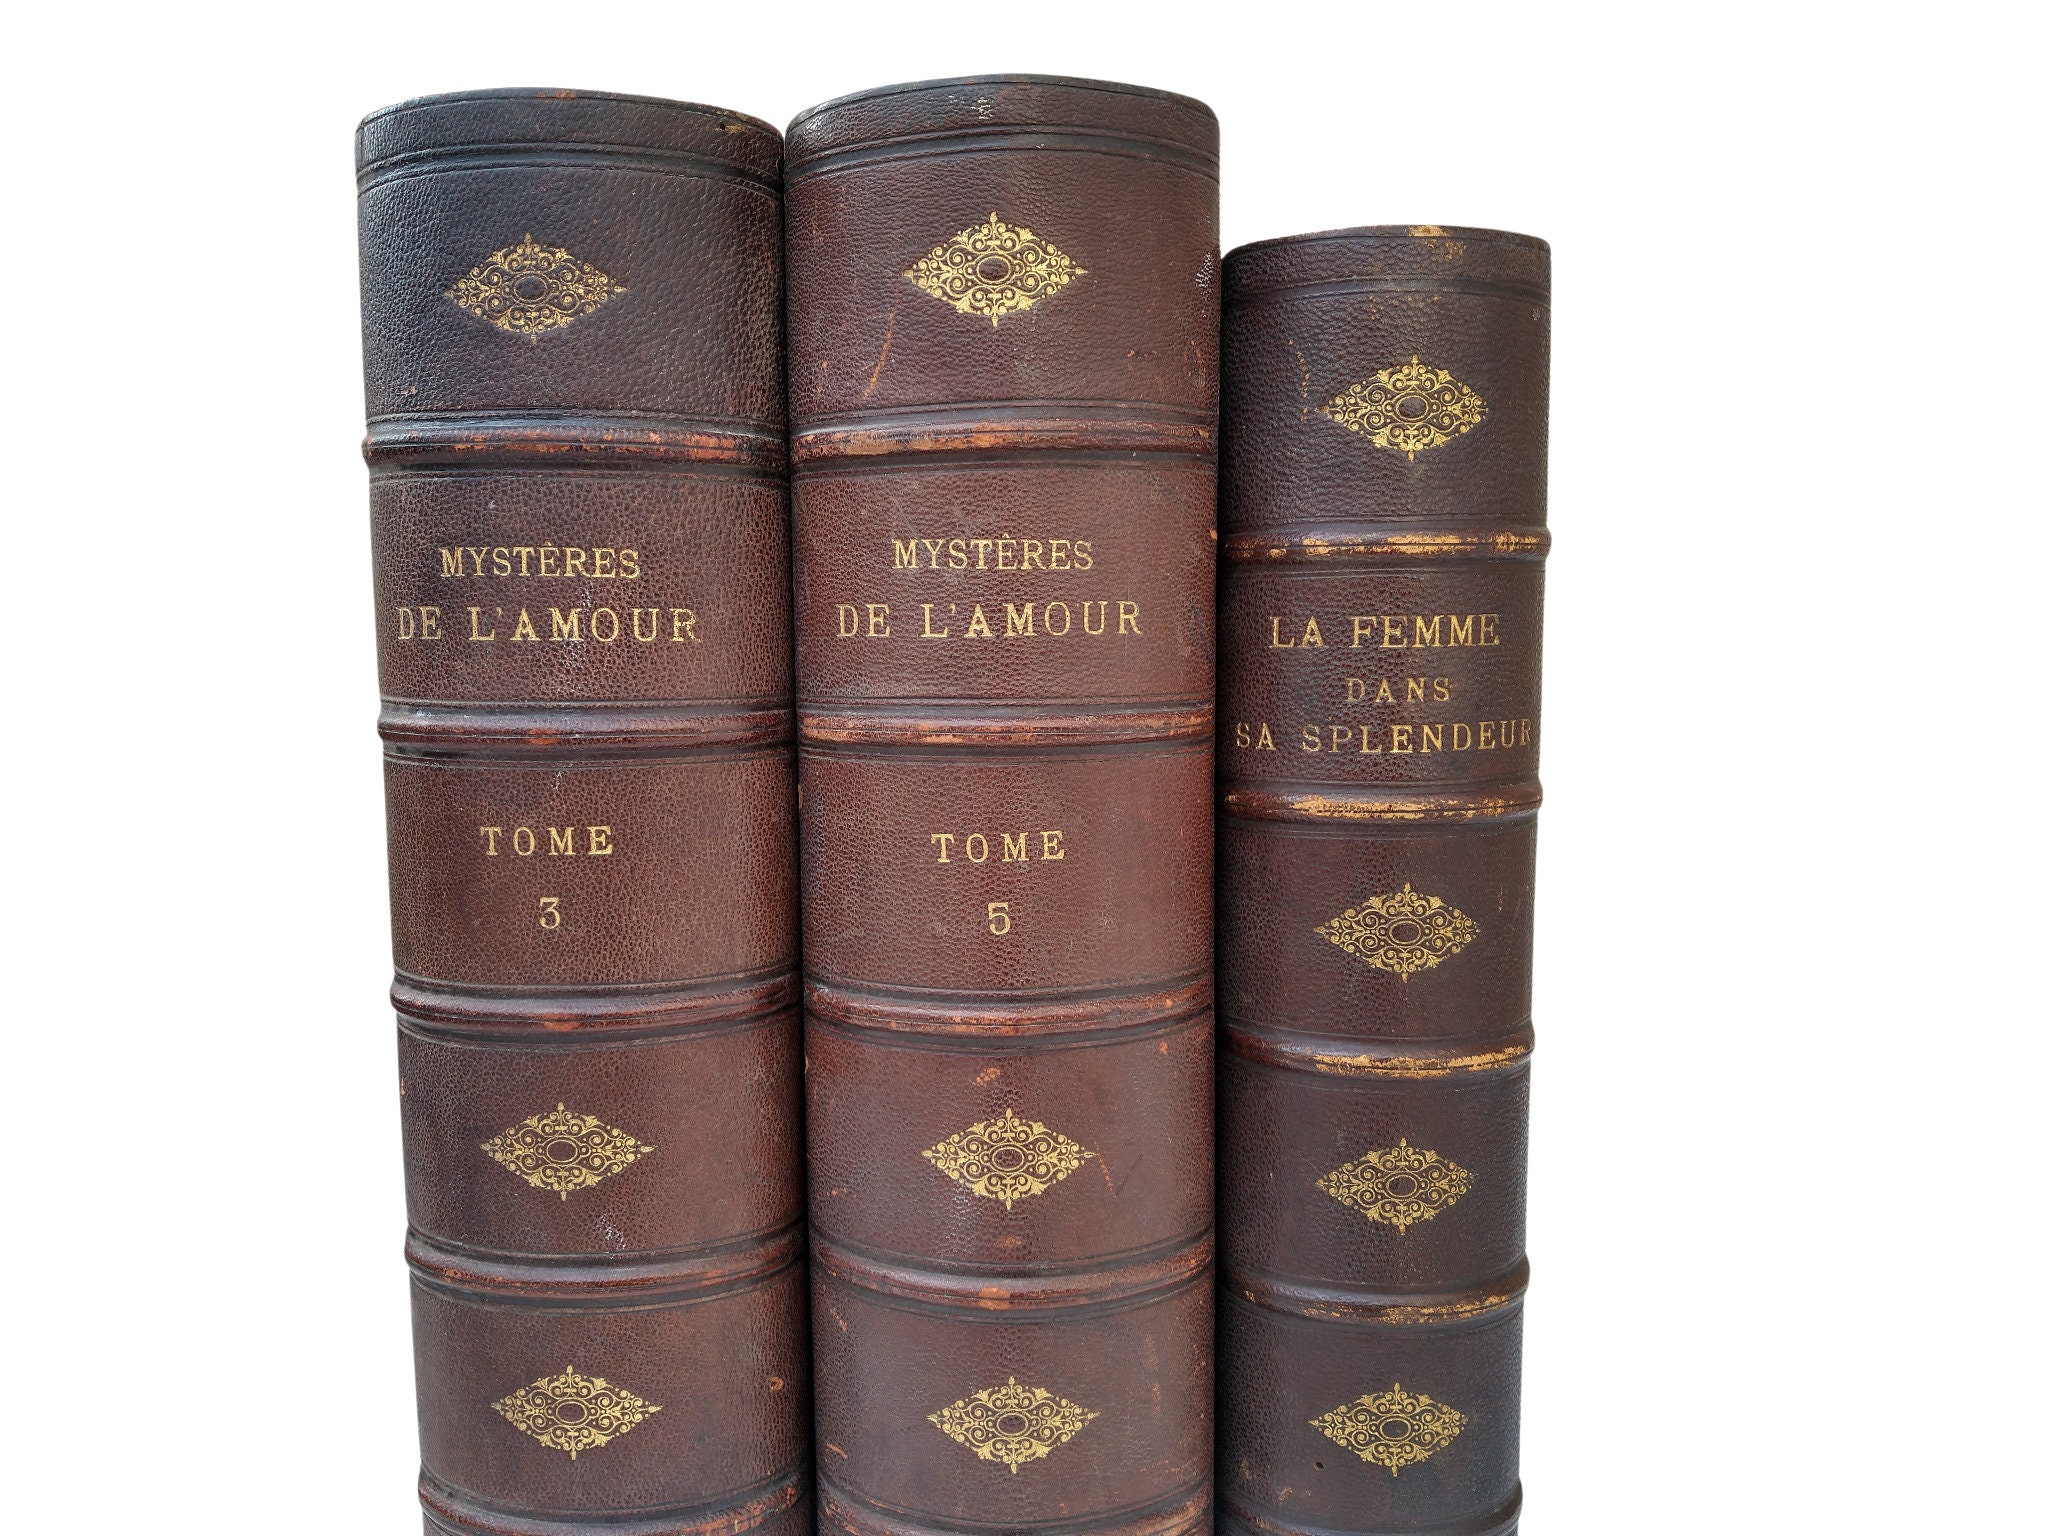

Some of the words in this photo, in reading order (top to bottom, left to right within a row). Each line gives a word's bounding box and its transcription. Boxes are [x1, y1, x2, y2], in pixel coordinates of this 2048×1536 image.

[395, 605, 442, 640] DE
[466, 605, 702, 643] L'AMOUR
[836, 602, 892, 638] DE
[919, 600, 1142, 638] L'AMOUR
[1268, 615, 1328, 649] LA
[1349, 613, 1501, 649] FEMME
[1346, 676, 1451, 703] DANS
[1236, 721, 1278, 751] SA
[1301, 717, 1532, 754] SPLENDEUR
[480, 825, 613, 857] TOME
[930, 830, 1065, 863] TOME
[538, 896, 562, 930] 3
[987, 901, 1012, 936] 5
